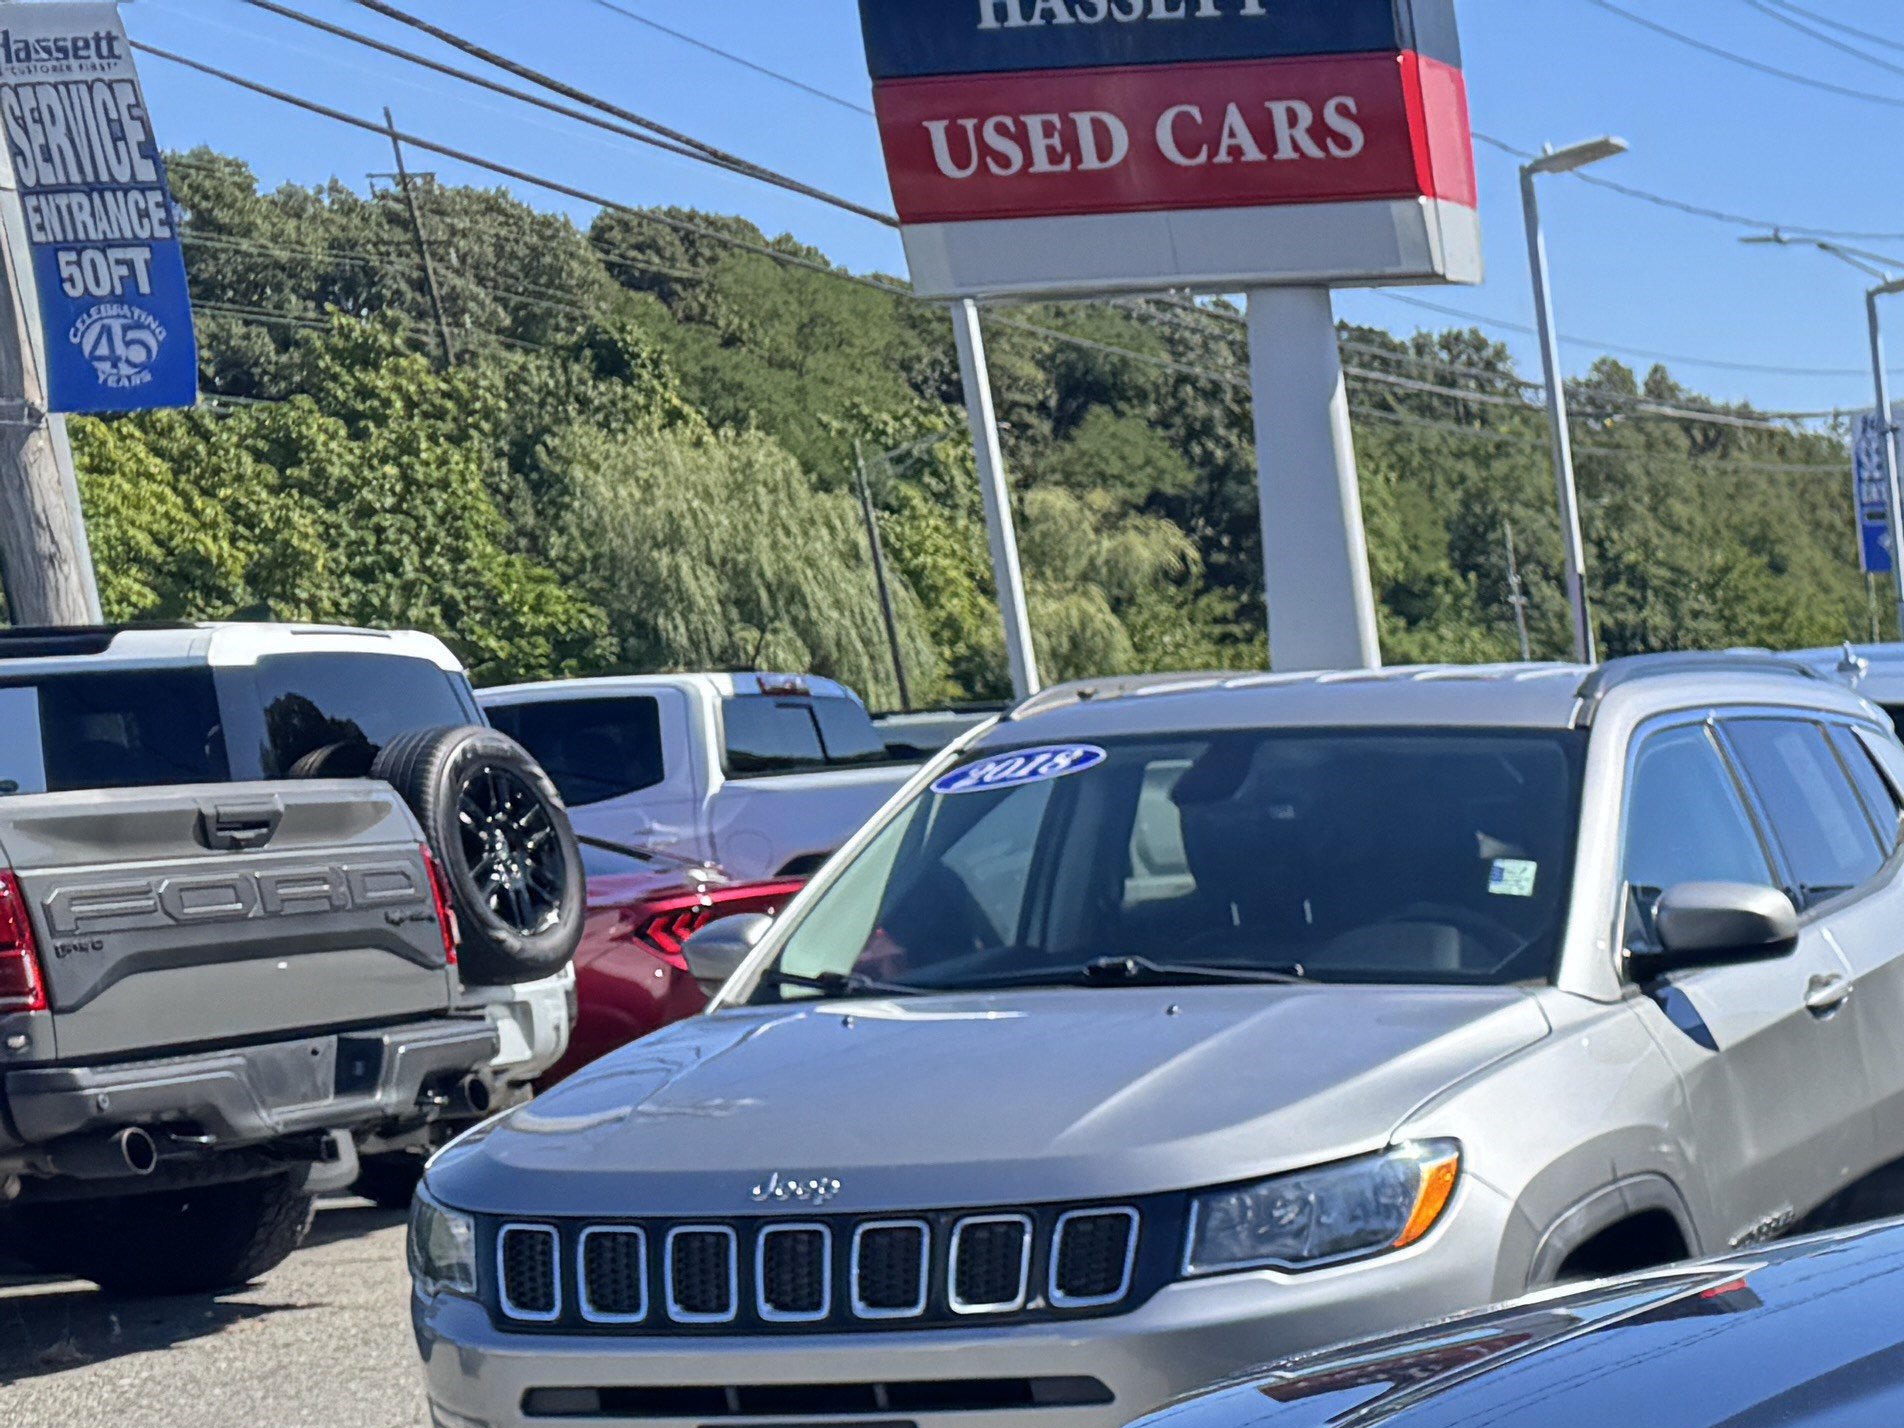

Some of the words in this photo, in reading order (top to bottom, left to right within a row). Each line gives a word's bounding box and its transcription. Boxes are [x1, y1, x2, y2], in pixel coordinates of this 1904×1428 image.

[0, 78, 158, 188] SERVICE
[922, 111, 1129, 179] USED
[1155, 96, 1365, 167] CARS
[23, 188, 172, 243] ENTRANCE
[57, 246, 152, 299] 50FT
[97, 368, 152, 388] YEARS
[951, 749, 1084, 791] 2018
[42, 859, 427, 940] FORD
[752, 1171, 841, 1206] Jeep
